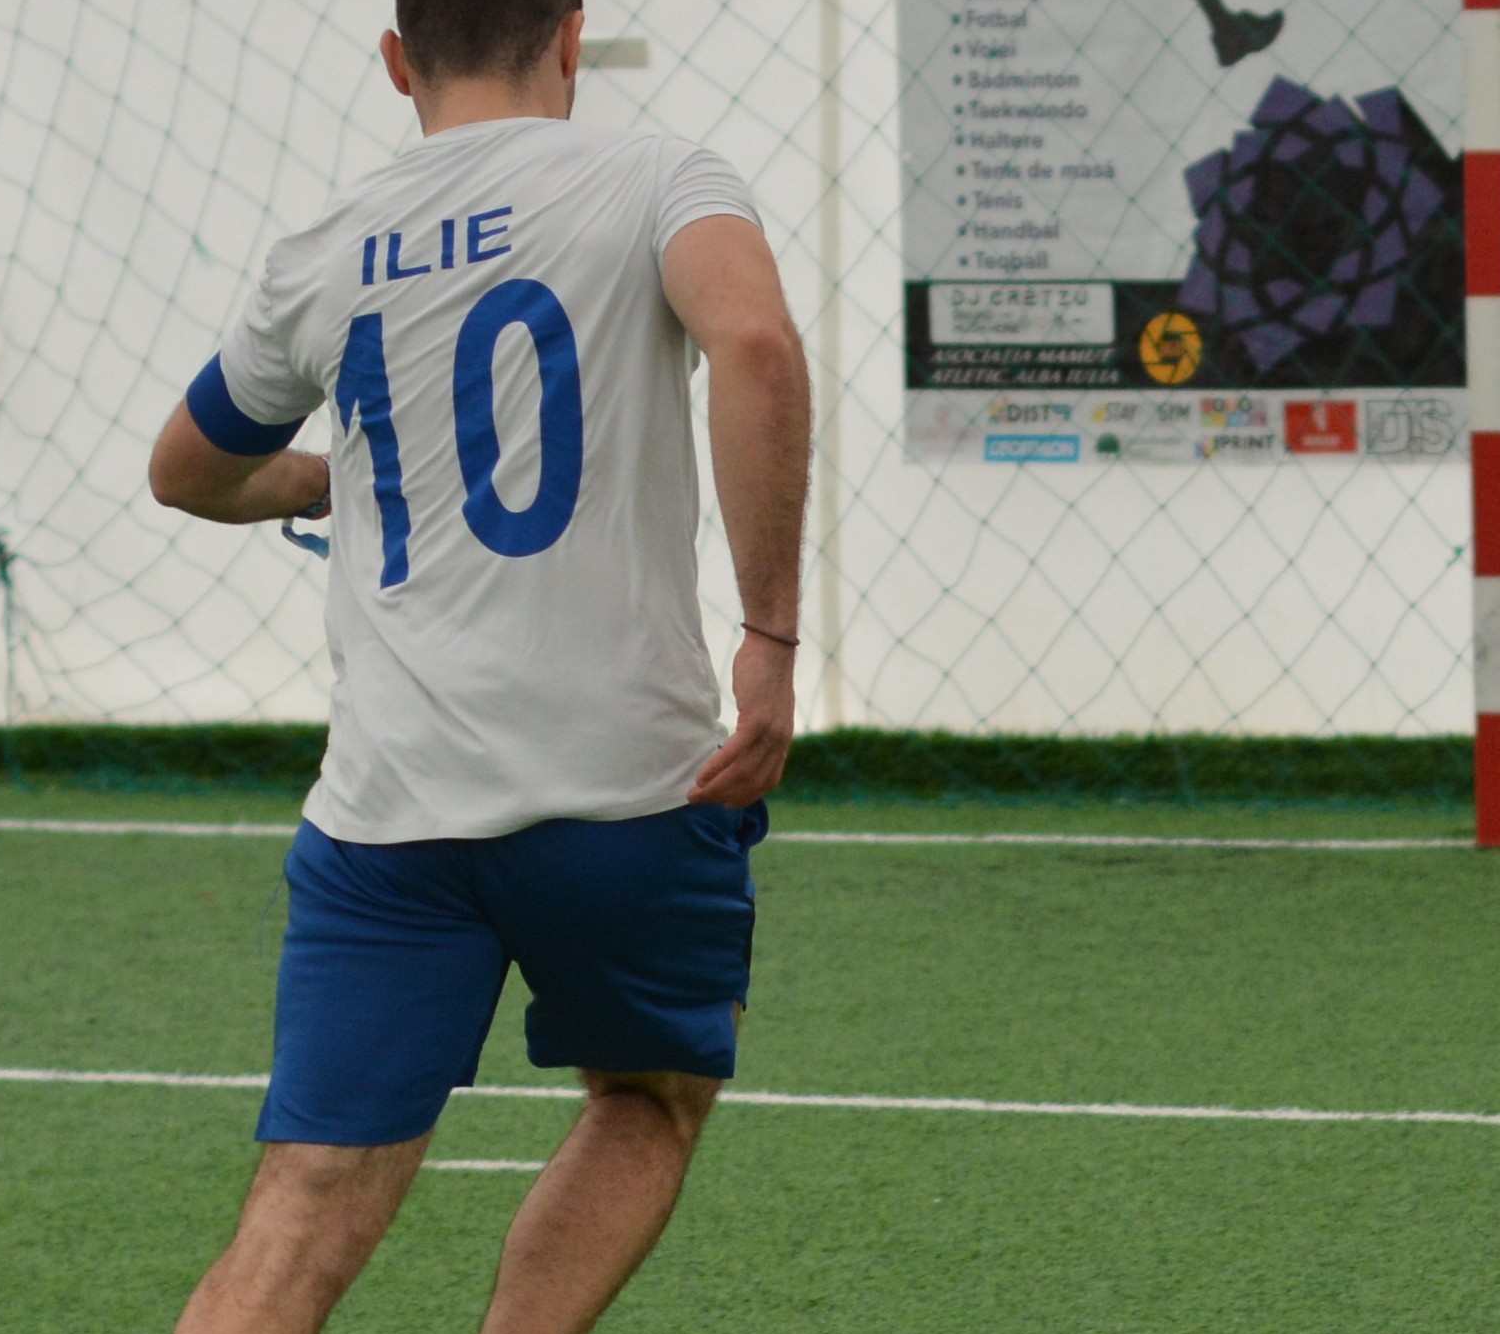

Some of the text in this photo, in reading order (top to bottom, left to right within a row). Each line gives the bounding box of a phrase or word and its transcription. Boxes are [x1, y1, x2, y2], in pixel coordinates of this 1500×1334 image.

[969, 70, 1080, 89] Badminton
[971, 99, 1088, 118] Taekwondo
[975, 220, 1059, 240] Handbal
[362, 206, 513, 286] ILIE
[335, 278, 584, 589] 10
